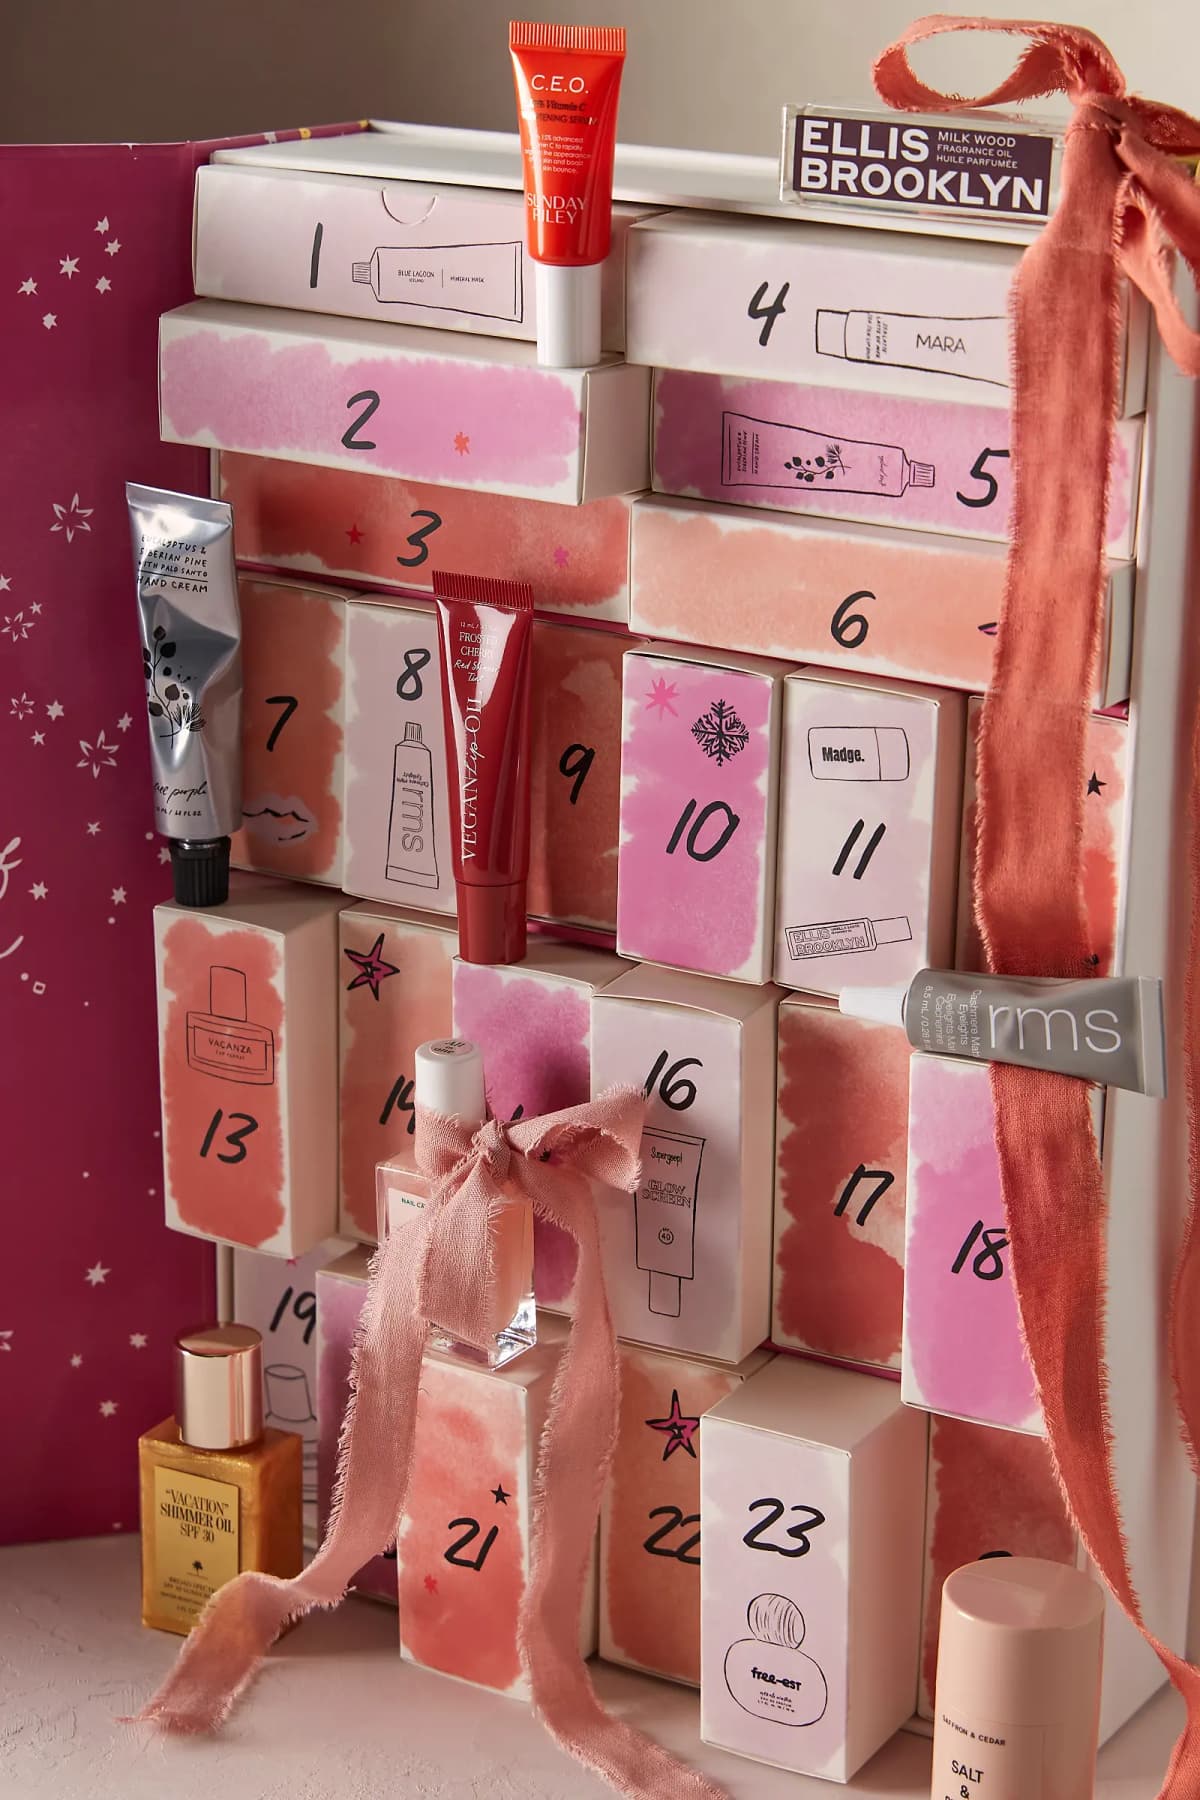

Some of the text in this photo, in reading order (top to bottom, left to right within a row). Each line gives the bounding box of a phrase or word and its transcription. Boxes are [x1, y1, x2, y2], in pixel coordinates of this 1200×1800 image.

[531, 74, 589, 94] C.E.O.
[802, 119, 930, 163] ELLIS
[937, 131, 1016, 148] MILK WOOD
[937, 144, 1012, 158] FRAGRANCE OIL
[936, 154, 1018, 169] HUILE PARFUMÉE
[527, 193, 586, 210] SUNDAY
[800, 157, 1043, 211] BROOKLYN
[533, 208, 578, 225] RILEY
[310, 223, 323, 288] 1
[413, 270, 435, 278] LAGOON
[748, 282, 790, 346] 4
[915, 333, 967, 354] MARA
[341, 390, 380, 449] 2
[956, 448, 1010, 507] 5
[139, 547, 208, 567] SBERIAN PINE
[396, 510, 442, 566] 3
[136, 576, 208, 593] HAND CREAM
[138, 561, 208, 577] ITH PALO SANTO
[830, 591, 876, 648] 6
[396, 649, 431, 700] 8
[454, 659, 471, 670] Red
[265, 696, 298, 753] 7
[559, 744, 596, 806] 9
[822, 746, 865, 763] Madge.
[402, 787, 424, 853] rms
[461, 776, 479, 863] VEGAN
[666, 799, 740, 862] 10
[832, 819, 886, 880] 11
[793, 928, 831, 944] ELLIS
[795, 935, 865, 955] BROOKLYN
[944, 993, 957, 1034] Eyelights
[957, 1004, 969, 1046] Eyelights
[969, 989, 983, 1035] Cashmere
[988, 1004, 1122, 1053] rms
[208, 1037, 252, 1054] VACANZA
[643, 1051, 703, 1111] 16
[200, 1110, 258, 1163] 13
[402, 1197, 415, 1206] NAIL
[643, 1189, 692, 1208] SCREEN
[648, 1180, 686, 1195] GLOW
[834, 1164, 894, 1226] 17
[951, 1220, 1010, 1280] 18
[269, 1287, 317, 1344] 19
[160, 1503, 235, 1534] SHIMMER OIL
[180, 1524, 215, 1543] SPF 30
[643, 1506, 701, 1565] 22
[742, 1498, 826, 1557] 23
[445, 1517, 499, 1571] 21
[750, 1667, 802, 1691] free-est
[943, 1714, 968, 1736] SAFFRON
[978, 1734, 1006, 1747] CEDAR
[951, 1759, 985, 1784] SALT
[960, 1784, 970, 1799] &
